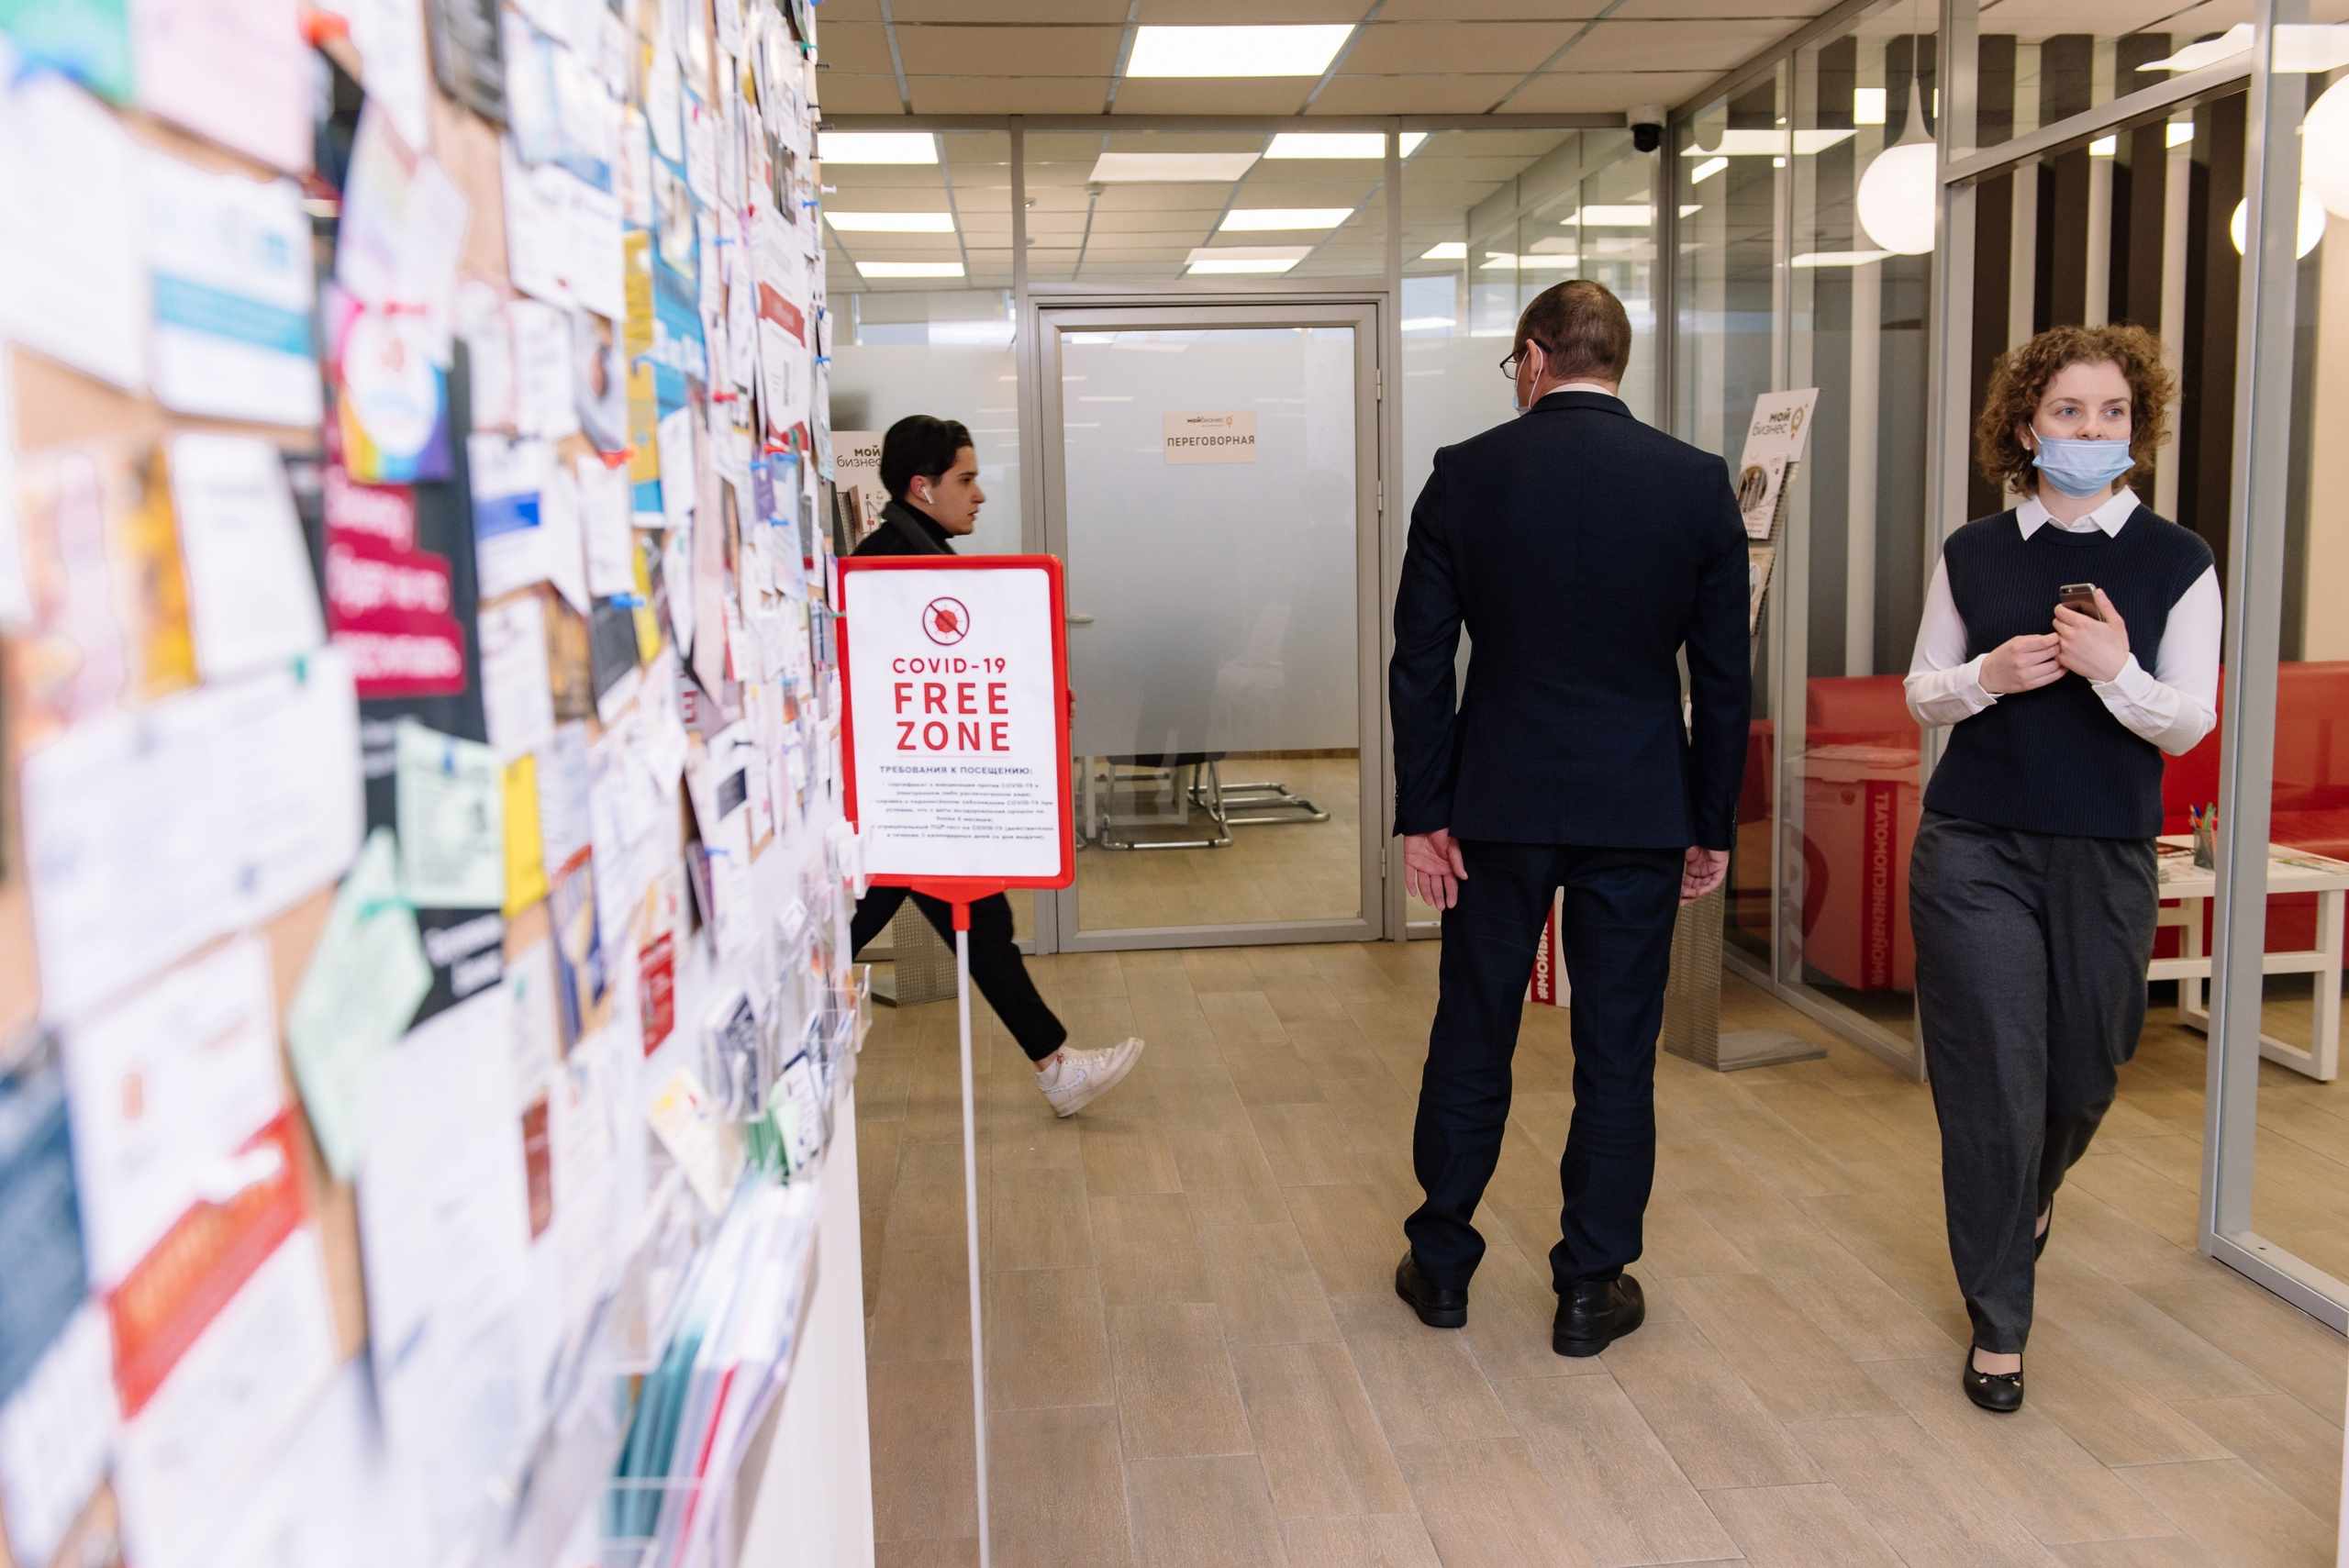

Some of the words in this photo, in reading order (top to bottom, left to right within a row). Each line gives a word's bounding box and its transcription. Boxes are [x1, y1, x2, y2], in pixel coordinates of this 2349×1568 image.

[1167, 435, 1255, 447] ПЕРЕГОВОРНАЯ
[854, 444, 881, 457] мой
[892, 657, 1006, 674] COVID-19
[894, 682, 1008, 715] FREE
[896, 720, 1010, 751] ZONE
[880, 765, 948, 773] ТРЕБОВАНИЯ
[960, 766, 1033, 775] ПОСЕЩЕНИЮ:
